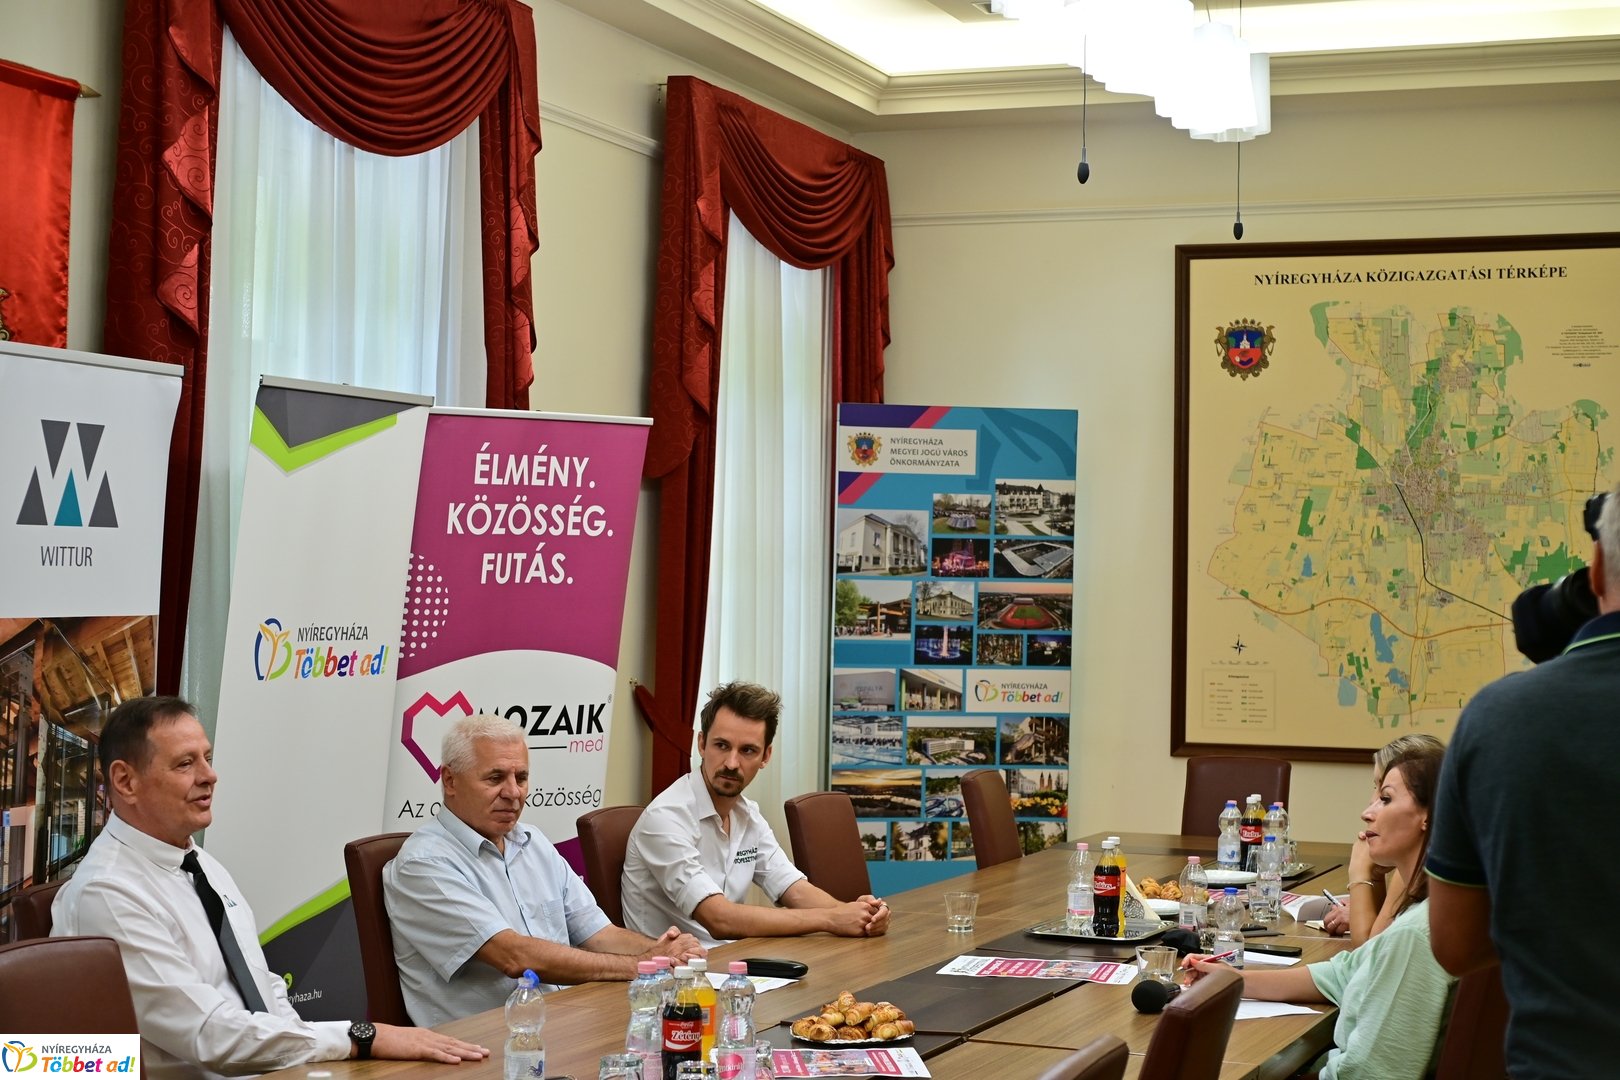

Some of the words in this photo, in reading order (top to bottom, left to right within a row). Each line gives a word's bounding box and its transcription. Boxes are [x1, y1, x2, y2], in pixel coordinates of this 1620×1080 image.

[1254, 269, 1362, 285] NYÍREGYHÁZA
[1366, 266, 1491, 283] KÖZIGAZGATÁSI
[1496, 264, 1568, 280] TÉRKÉPE
[890, 436, 944, 446] NYÍREGYHÁZA
[890, 448, 919, 456] MEGYEI
[943, 448, 968, 457] VÁROS
[890, 457, 960, 467] ÖNKORMÁNYZATA
[474, 442, 595, 488] ÉLMÉNY.
[447, 494, 613, 537] KÖZÖSSÉG.
[40, 546, 93, 567] WITTUR
[480, 542, 574, 585] FUTÁS.
[297, 622, 369, 642] NYÍREGYHÁZA
[294, 645, 358, 679] Többet
[359, 644, 389, 676] ad!
[1001, 681, 1048, 689] NYÍREGYHÁZA
[1001, 690, 1042, 703] Többet
[1044, 690, 1063, 703] ad!
[480, 703, 606, 736] OZAIK
[569, 735, 604, 753] med
[398, 799, 425, 818] Az
